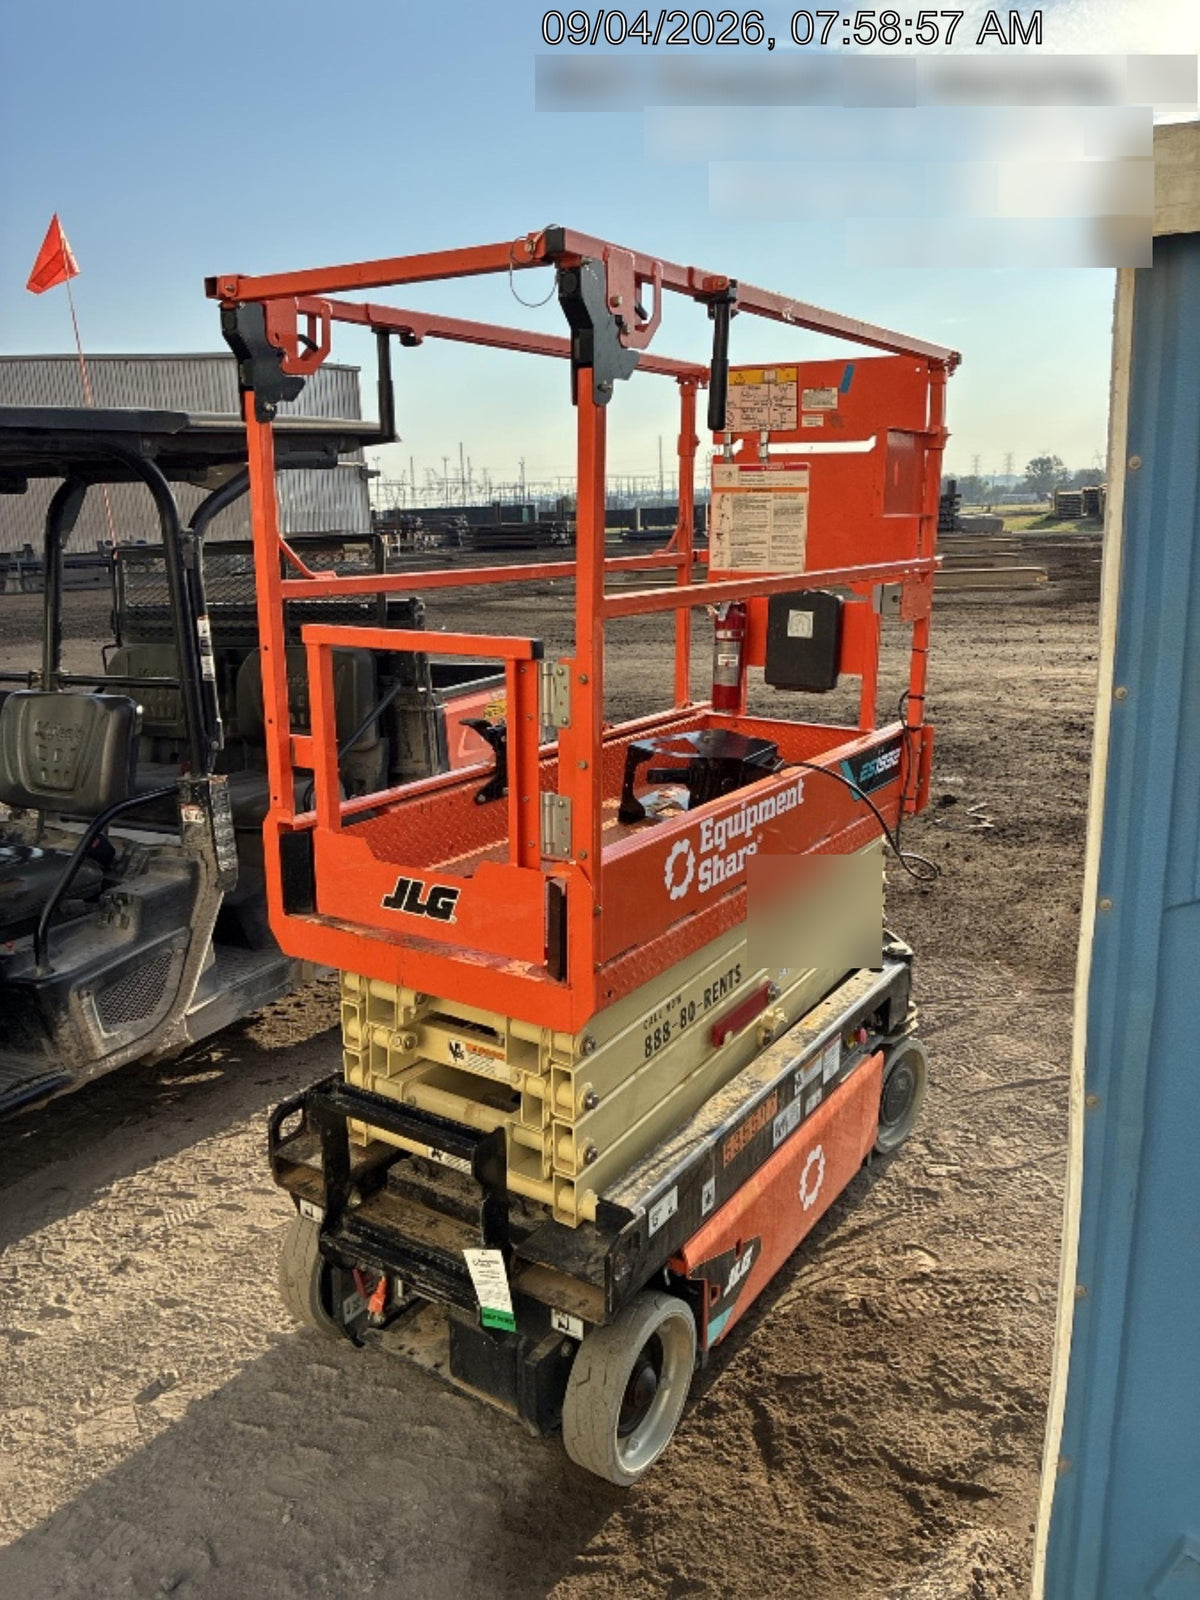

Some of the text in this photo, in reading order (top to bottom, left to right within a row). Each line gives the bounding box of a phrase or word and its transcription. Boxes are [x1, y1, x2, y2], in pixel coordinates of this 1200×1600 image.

[700, 779, 805, 854] Equipment
[380, 876, 461, 923] JLG
[644, 963, 742, 1059] 888-80-RENTS
